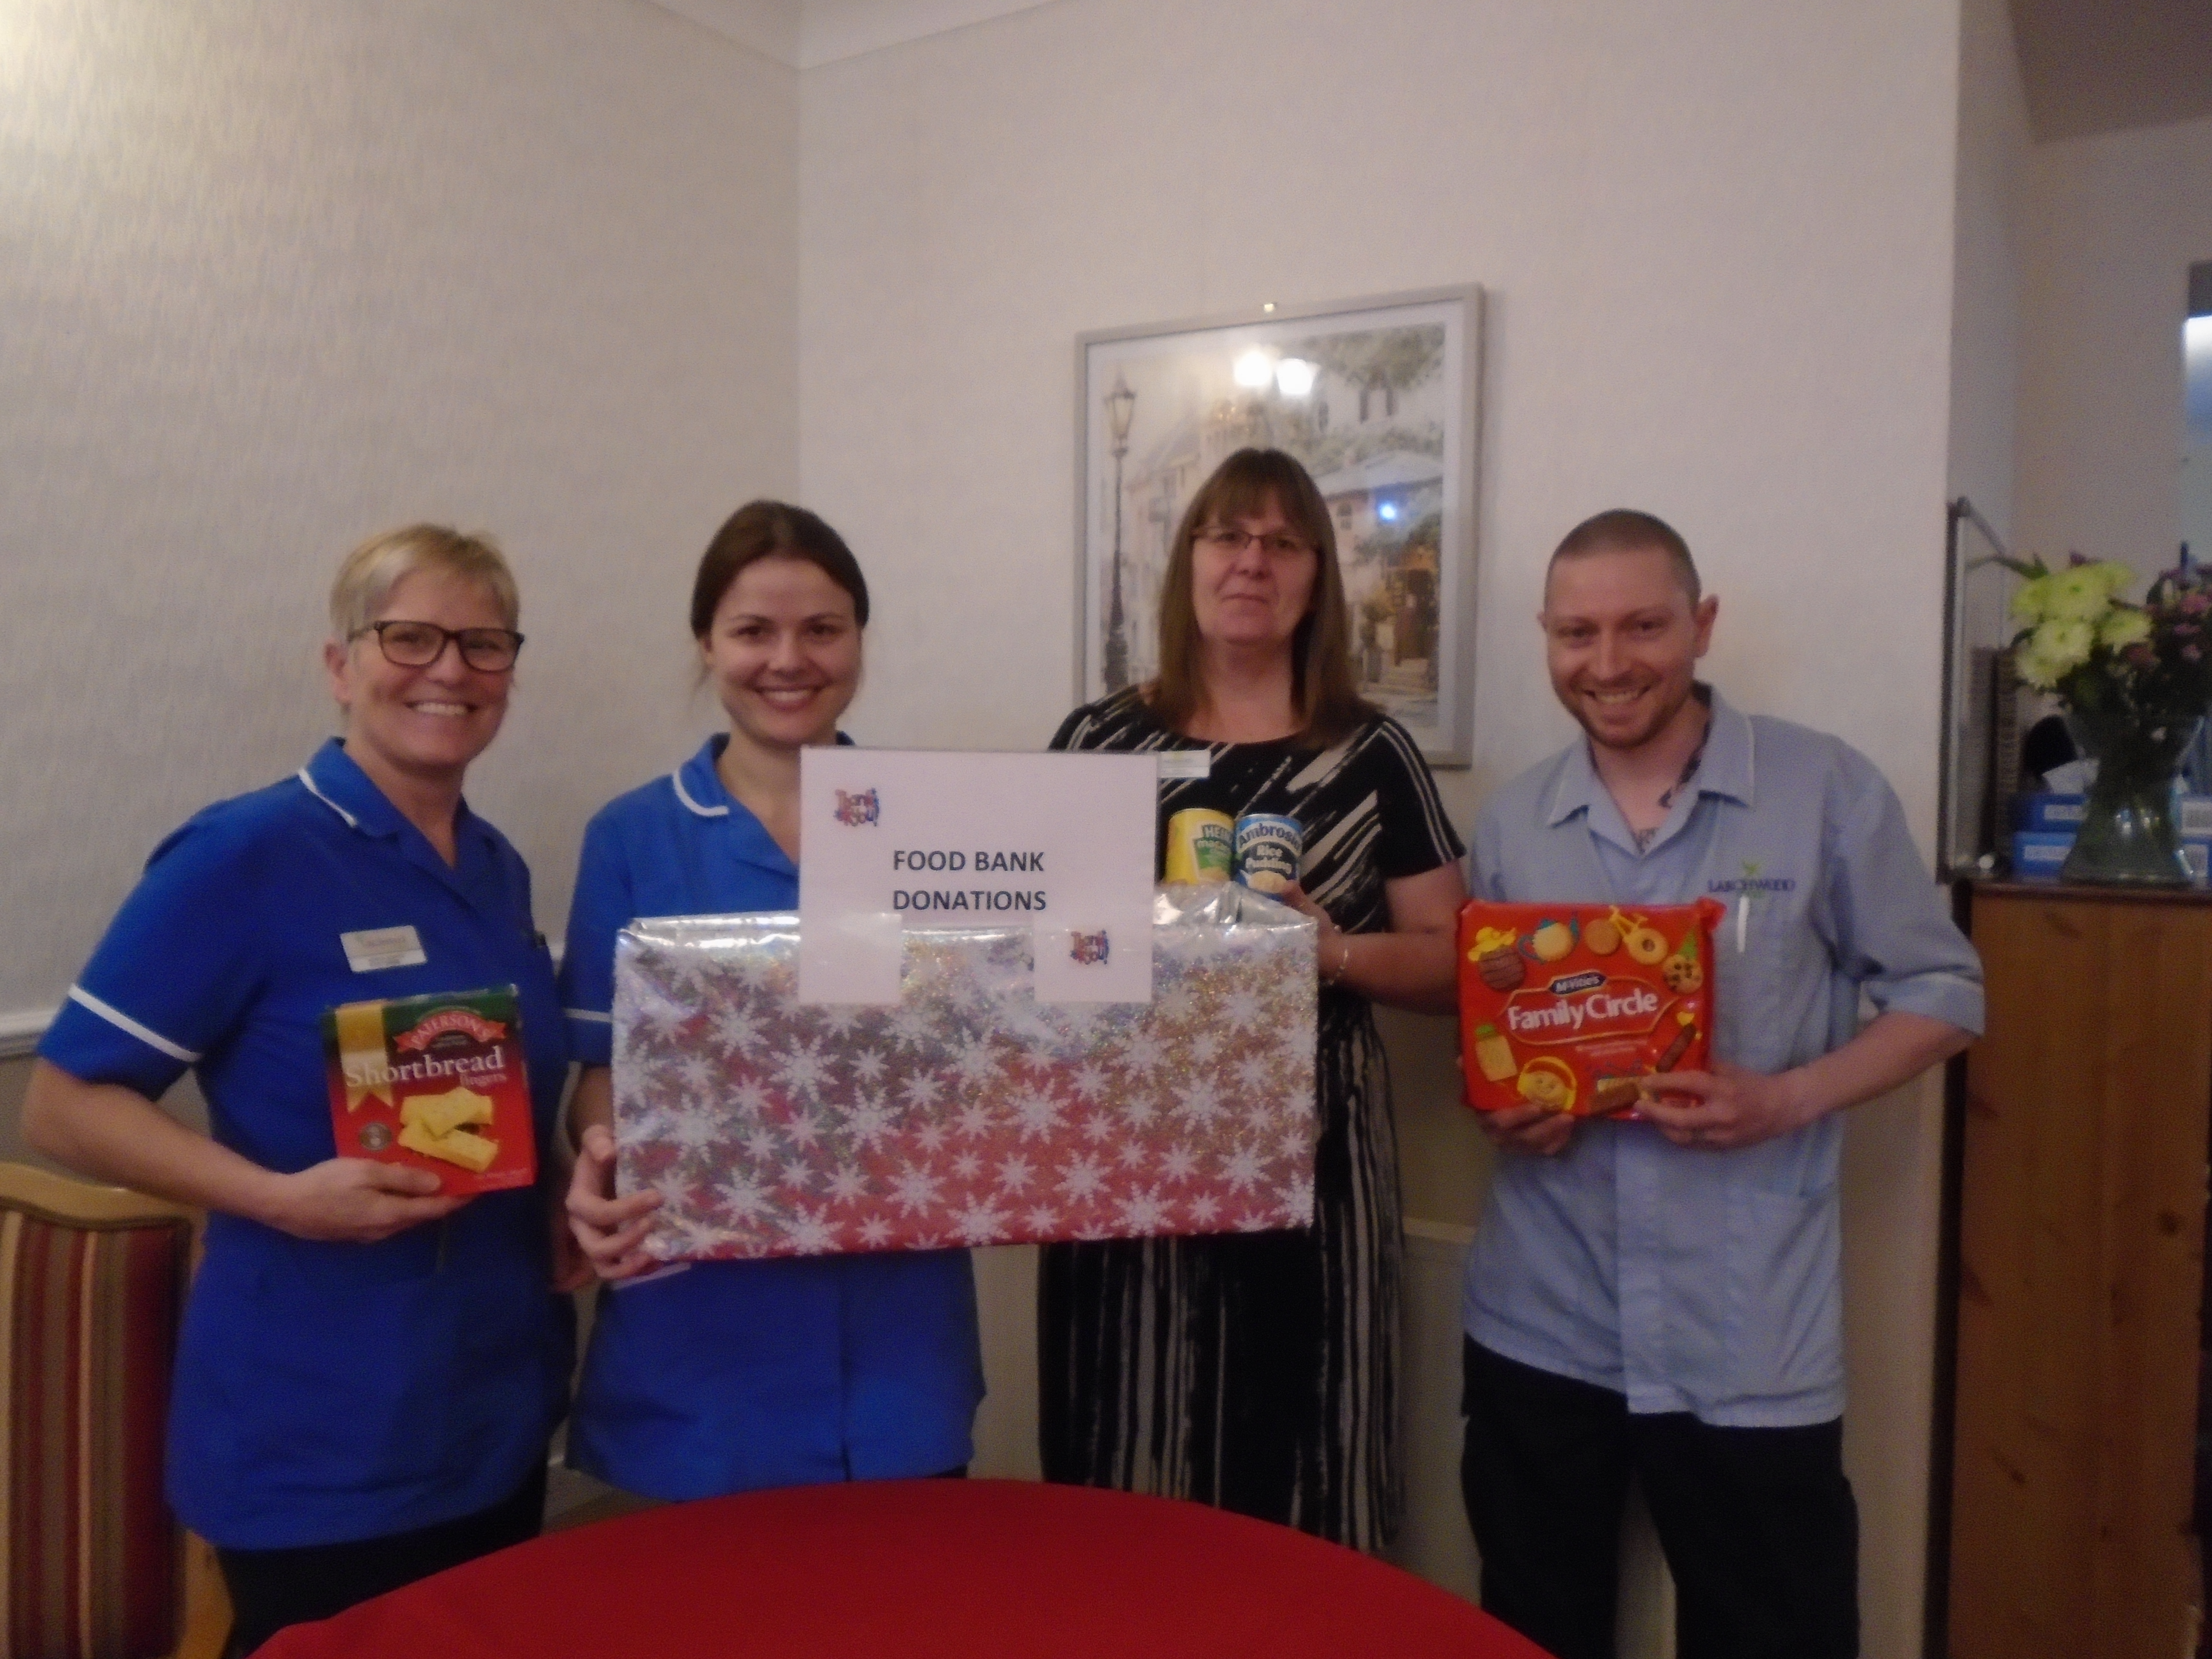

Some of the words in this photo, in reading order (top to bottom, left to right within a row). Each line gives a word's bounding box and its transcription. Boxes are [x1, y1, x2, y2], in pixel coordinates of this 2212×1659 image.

[893, 850, 966, 871] FOOD
[975, 851, 1045, 872] BANK
[1256, 845, 1283, 857] Rice
[1245, 857, 1292, 875] Pudding
[893, 890, 1046, 911] DONATIONS
[345, 1045, 505, 1087] Shortbread
